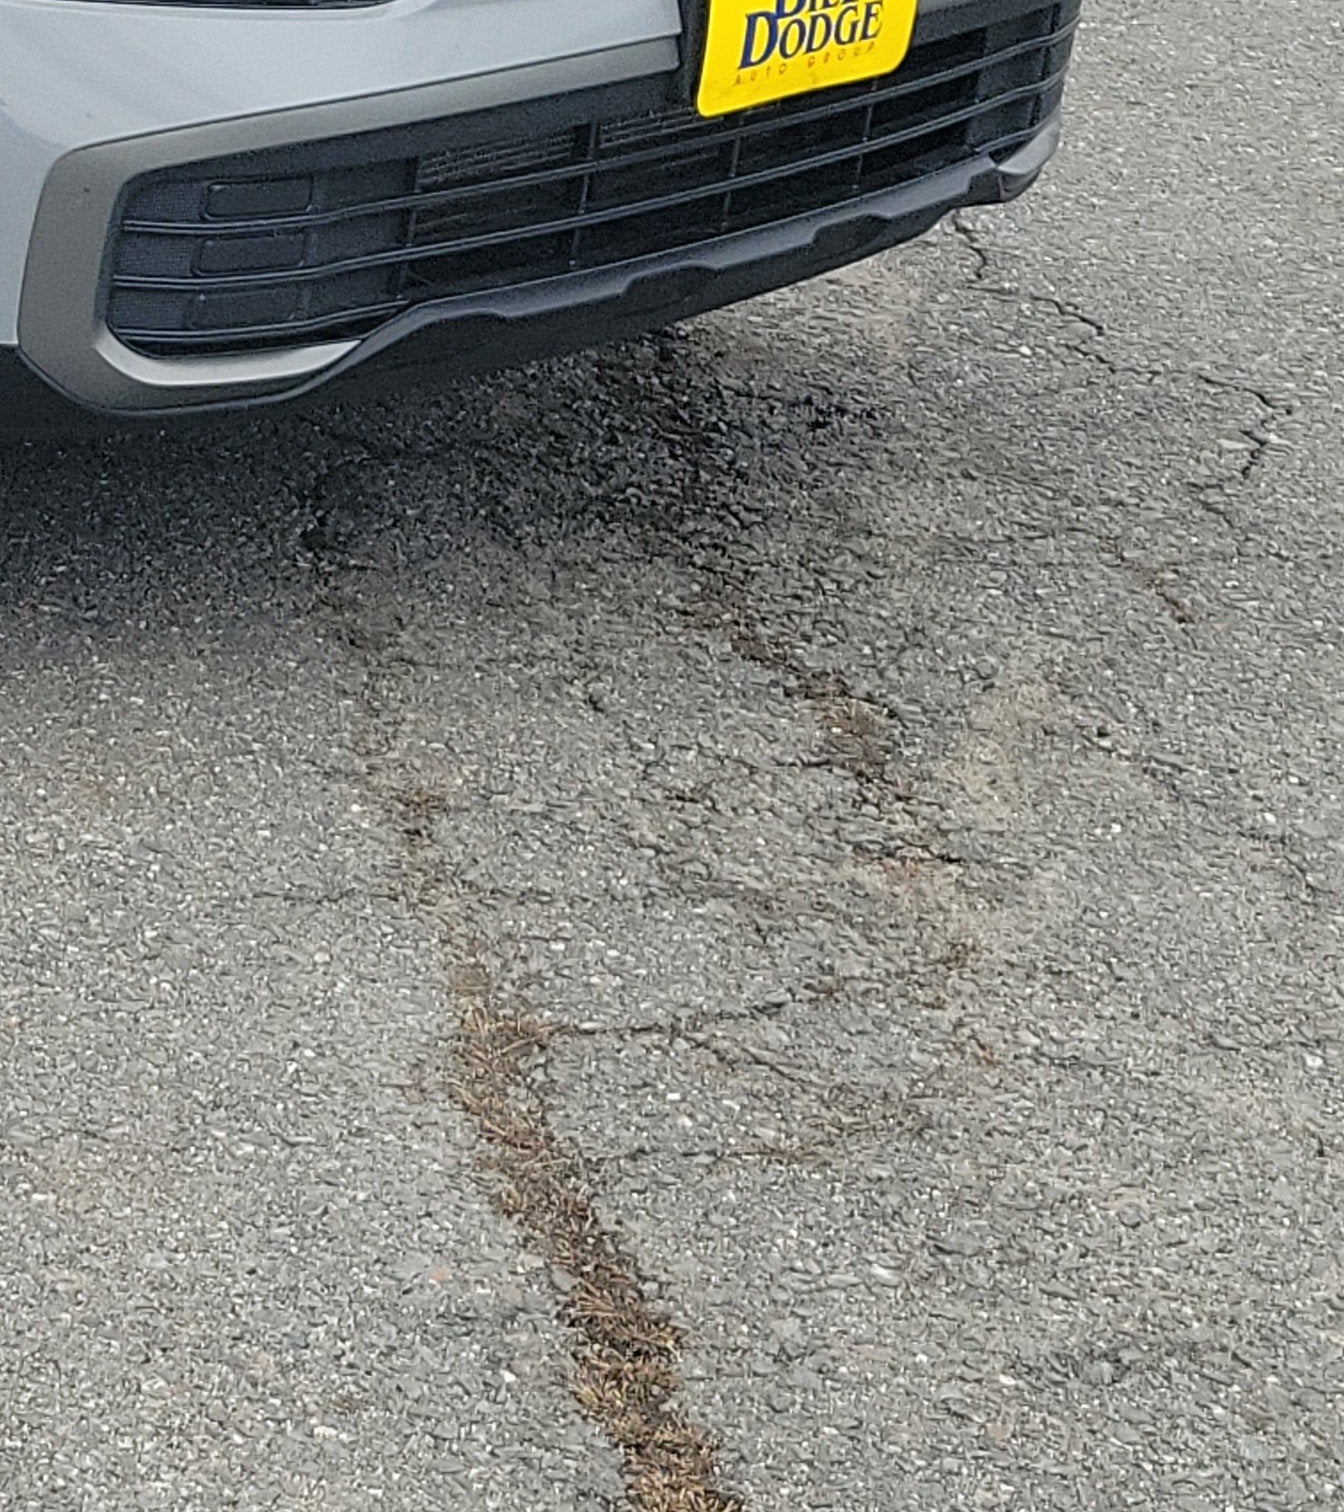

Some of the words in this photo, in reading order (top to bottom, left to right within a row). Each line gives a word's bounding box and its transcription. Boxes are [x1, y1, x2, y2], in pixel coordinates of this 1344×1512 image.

[738, 0, 884, 70] DODGE
[734, 63, 787, 86] AUTO
[807, 43, 875, 67] GROUP
